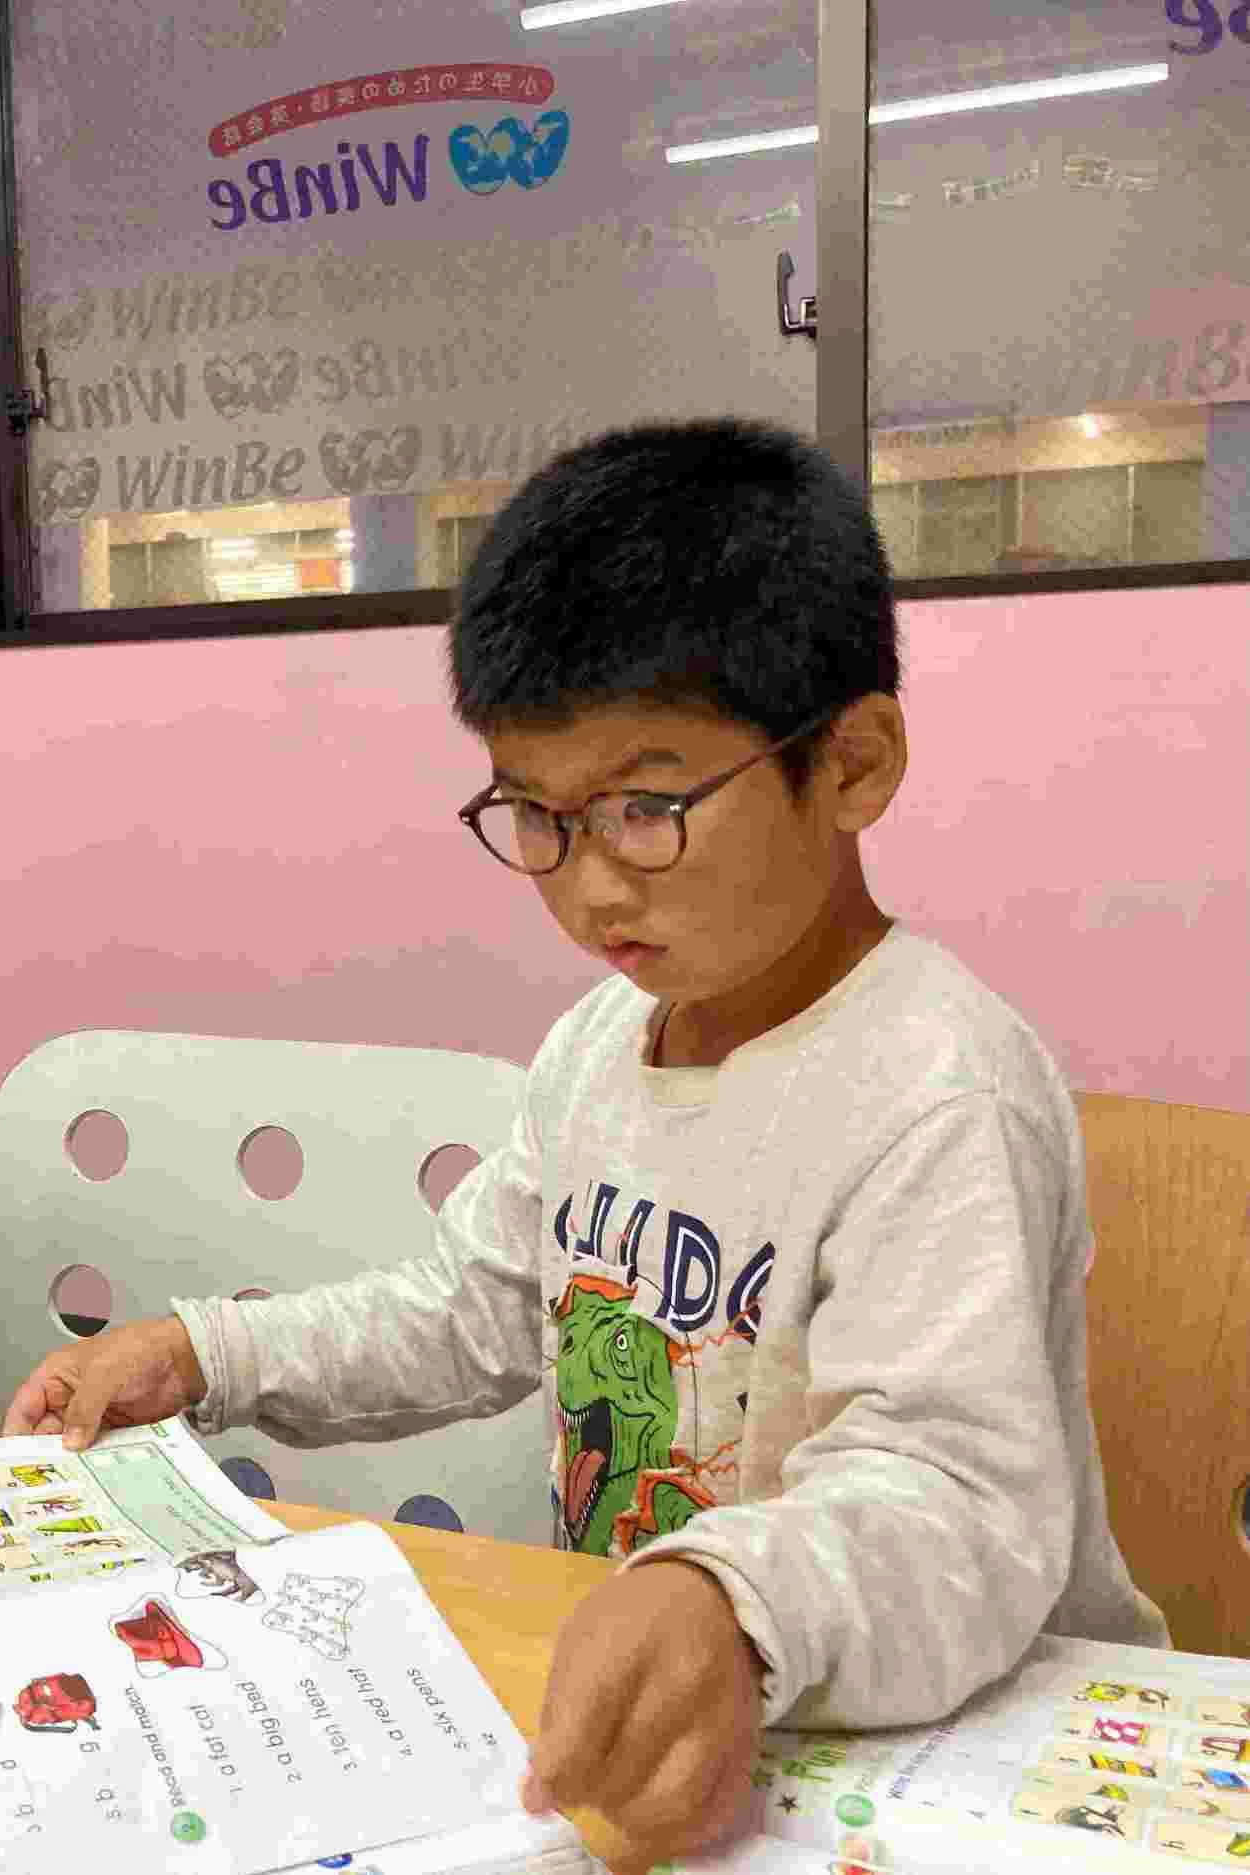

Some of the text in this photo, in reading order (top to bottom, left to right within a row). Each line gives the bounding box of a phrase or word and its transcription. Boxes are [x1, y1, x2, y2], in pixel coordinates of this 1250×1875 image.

[116, 440, 307, 512] WinBe
[236, 1681, 268, 1714] bed
[300, 1678, 331, 1720] hens
[407, 1668, 445, 1706] pens
[188, 1704, 214, 1730] cat
[363, 1697, 396, 1724] red
[434, 1711, 457, 1735] six
[261, 1717, 284, 1748] big
[389, 1729, 404, 1741] a
[79, 1741, 101, 1753] g
[142, 1733, 166, 1762] and
[203, 1736, 230, 1760] fat
[277, 1752, 292, 1765] a
[220, 1764, 236, 1776] a
